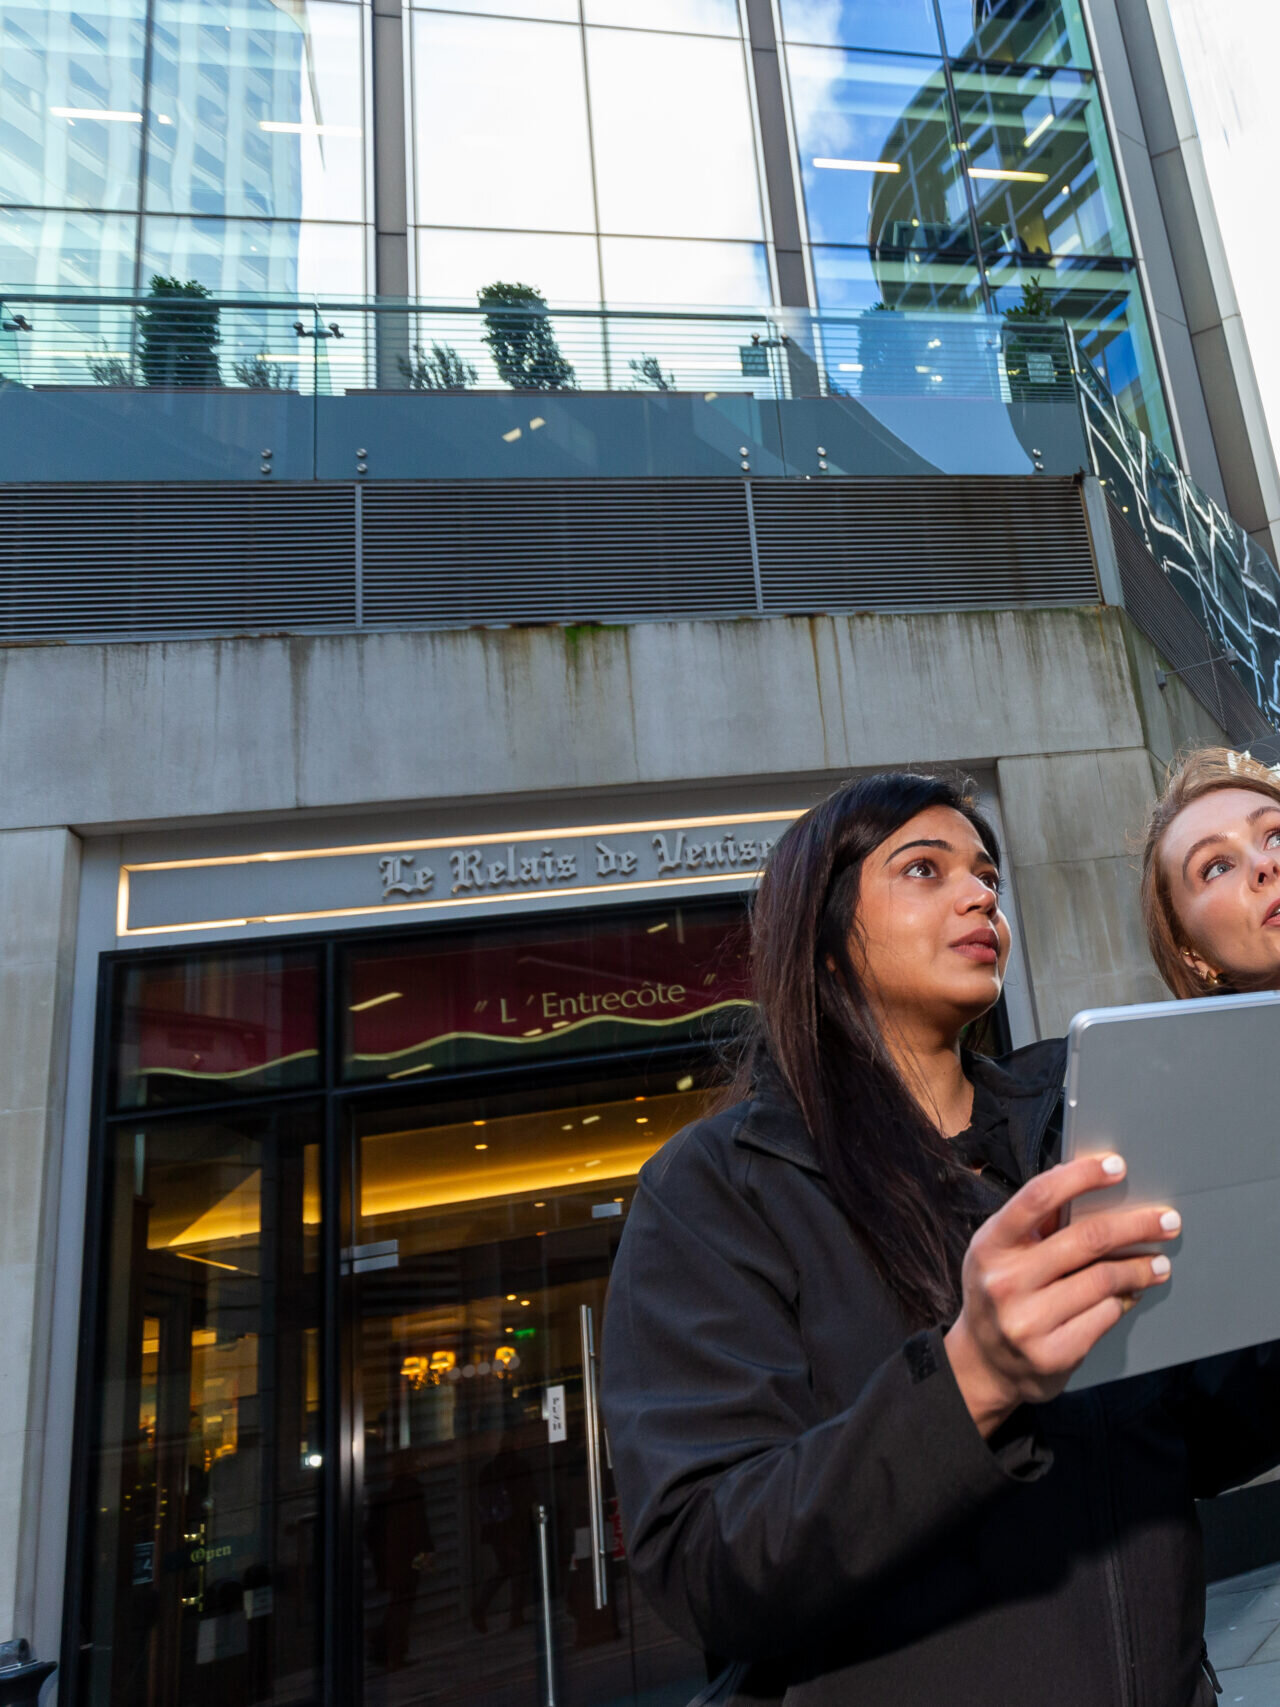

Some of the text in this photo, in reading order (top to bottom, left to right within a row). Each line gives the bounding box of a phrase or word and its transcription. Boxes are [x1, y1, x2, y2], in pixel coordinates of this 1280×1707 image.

[379, 831, 776, 898] Le Relais de Venise
[190, 1545, 232, 1563] Open
